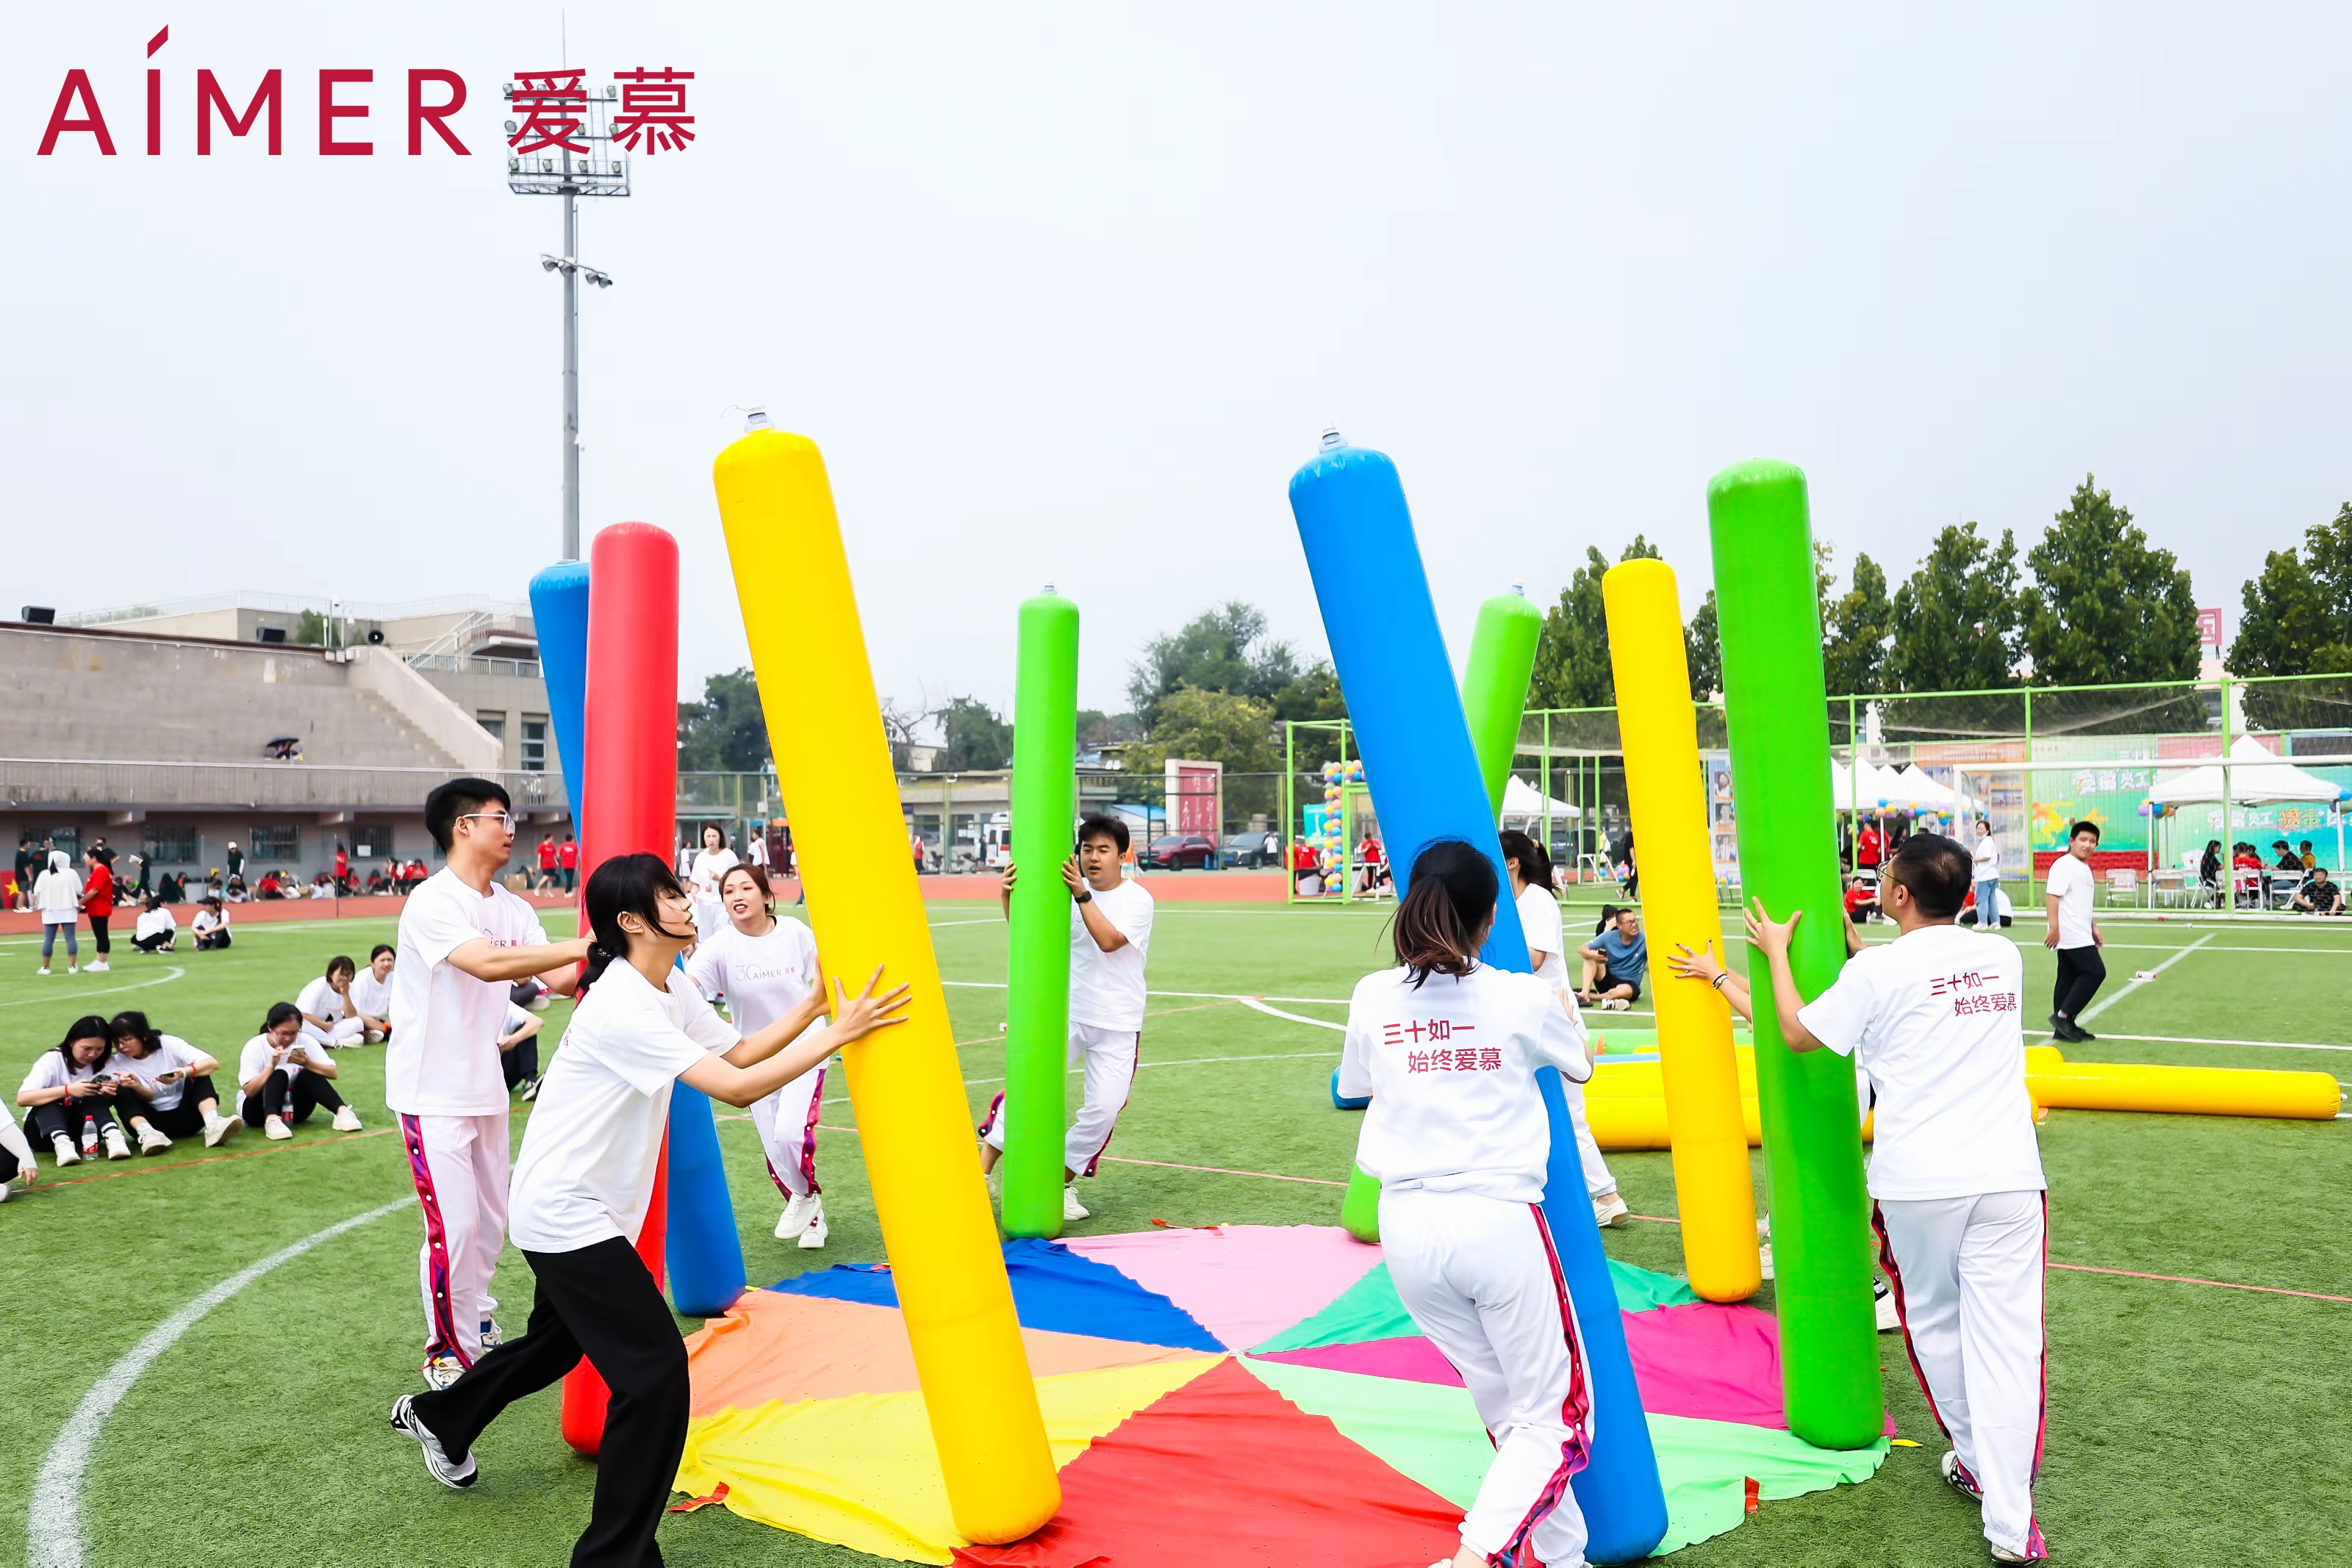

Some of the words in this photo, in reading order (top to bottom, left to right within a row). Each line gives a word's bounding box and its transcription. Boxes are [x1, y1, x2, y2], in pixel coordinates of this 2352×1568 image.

[1930, 972, 1998, 996] 三十如一
[1954, 992, 2017, 1016] 始终爱慕
[1383, 1019, 1475, 1045] 三十如一
[1408, 1048, 1501, 1073] 始终爱慕
